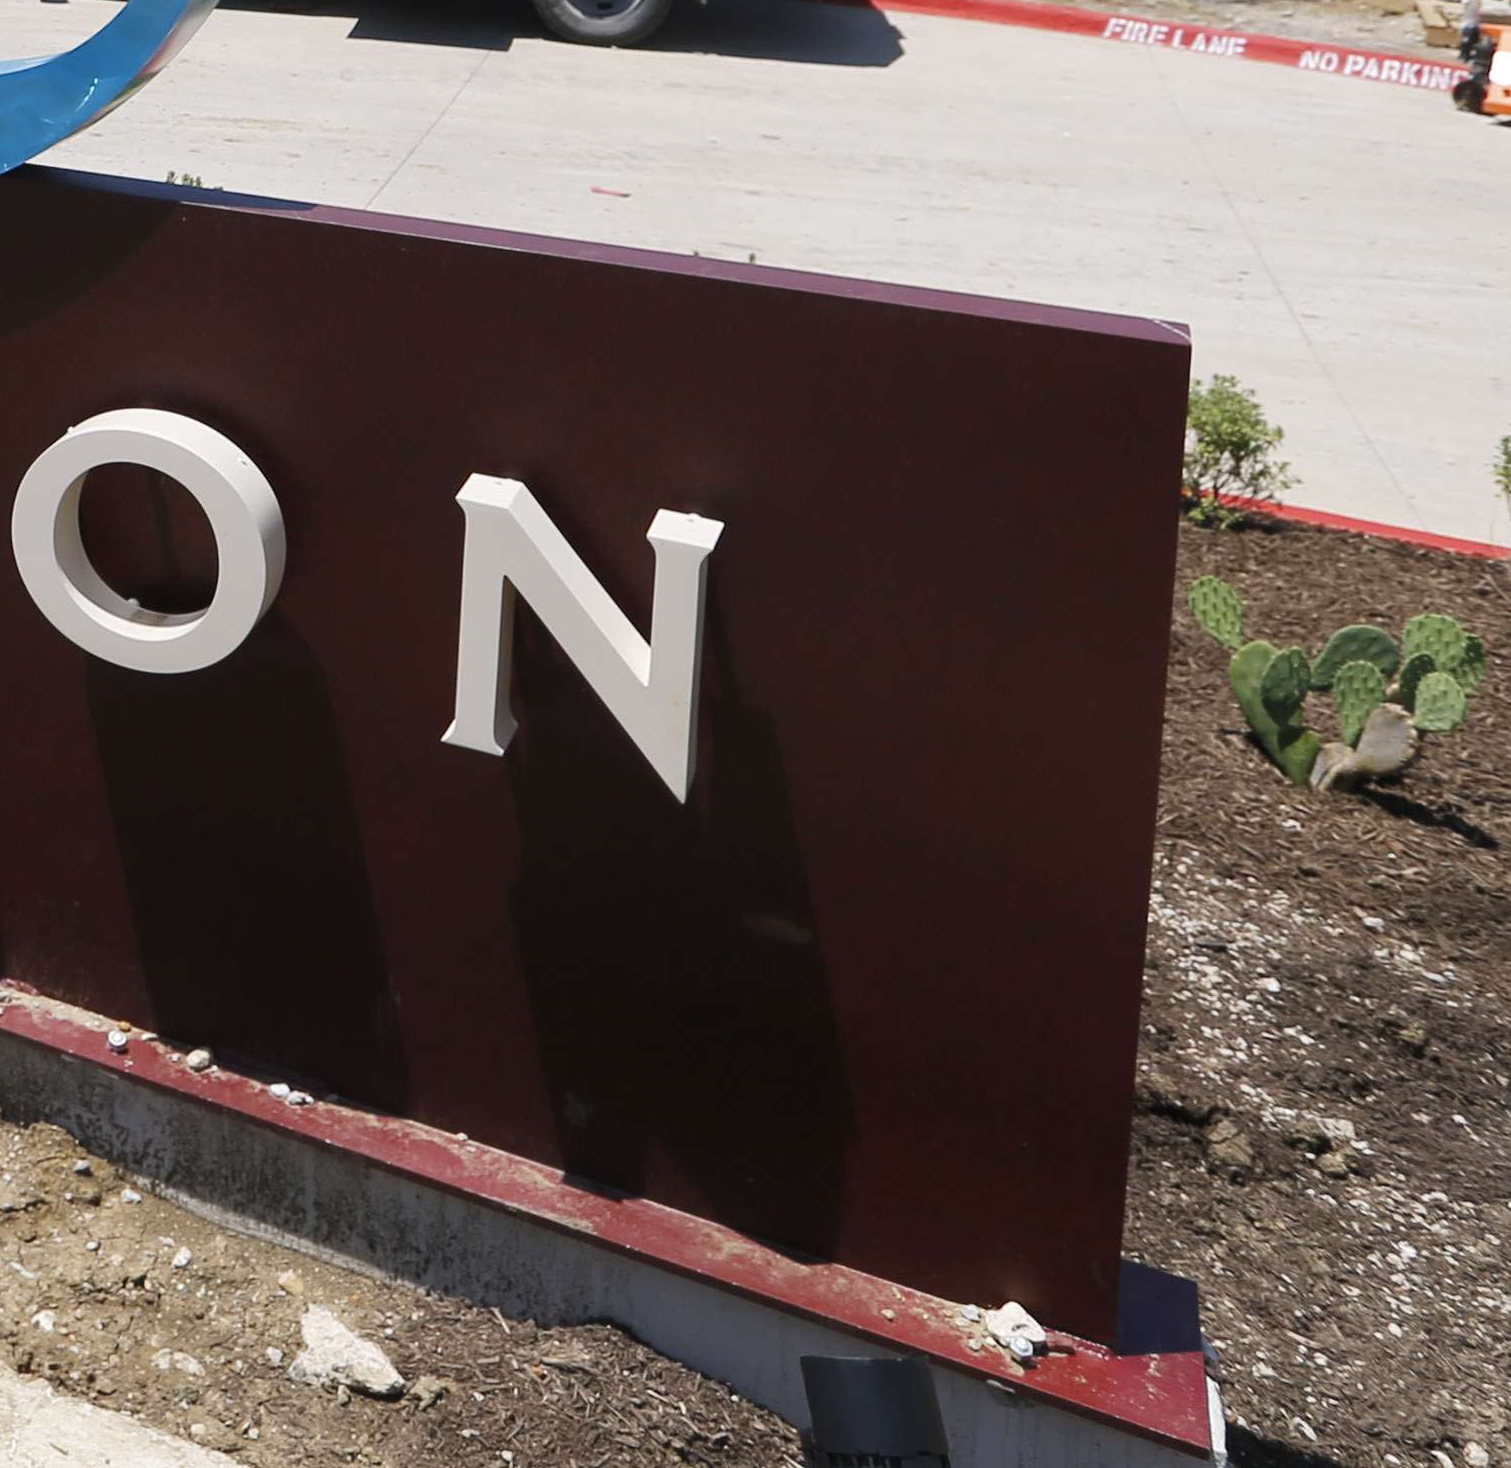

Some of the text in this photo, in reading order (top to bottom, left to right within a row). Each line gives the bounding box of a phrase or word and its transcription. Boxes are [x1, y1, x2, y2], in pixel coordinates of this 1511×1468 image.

[1103, 17, 1247, 56] FIRE LANE
[1298, 50, 1339, 72] NO
